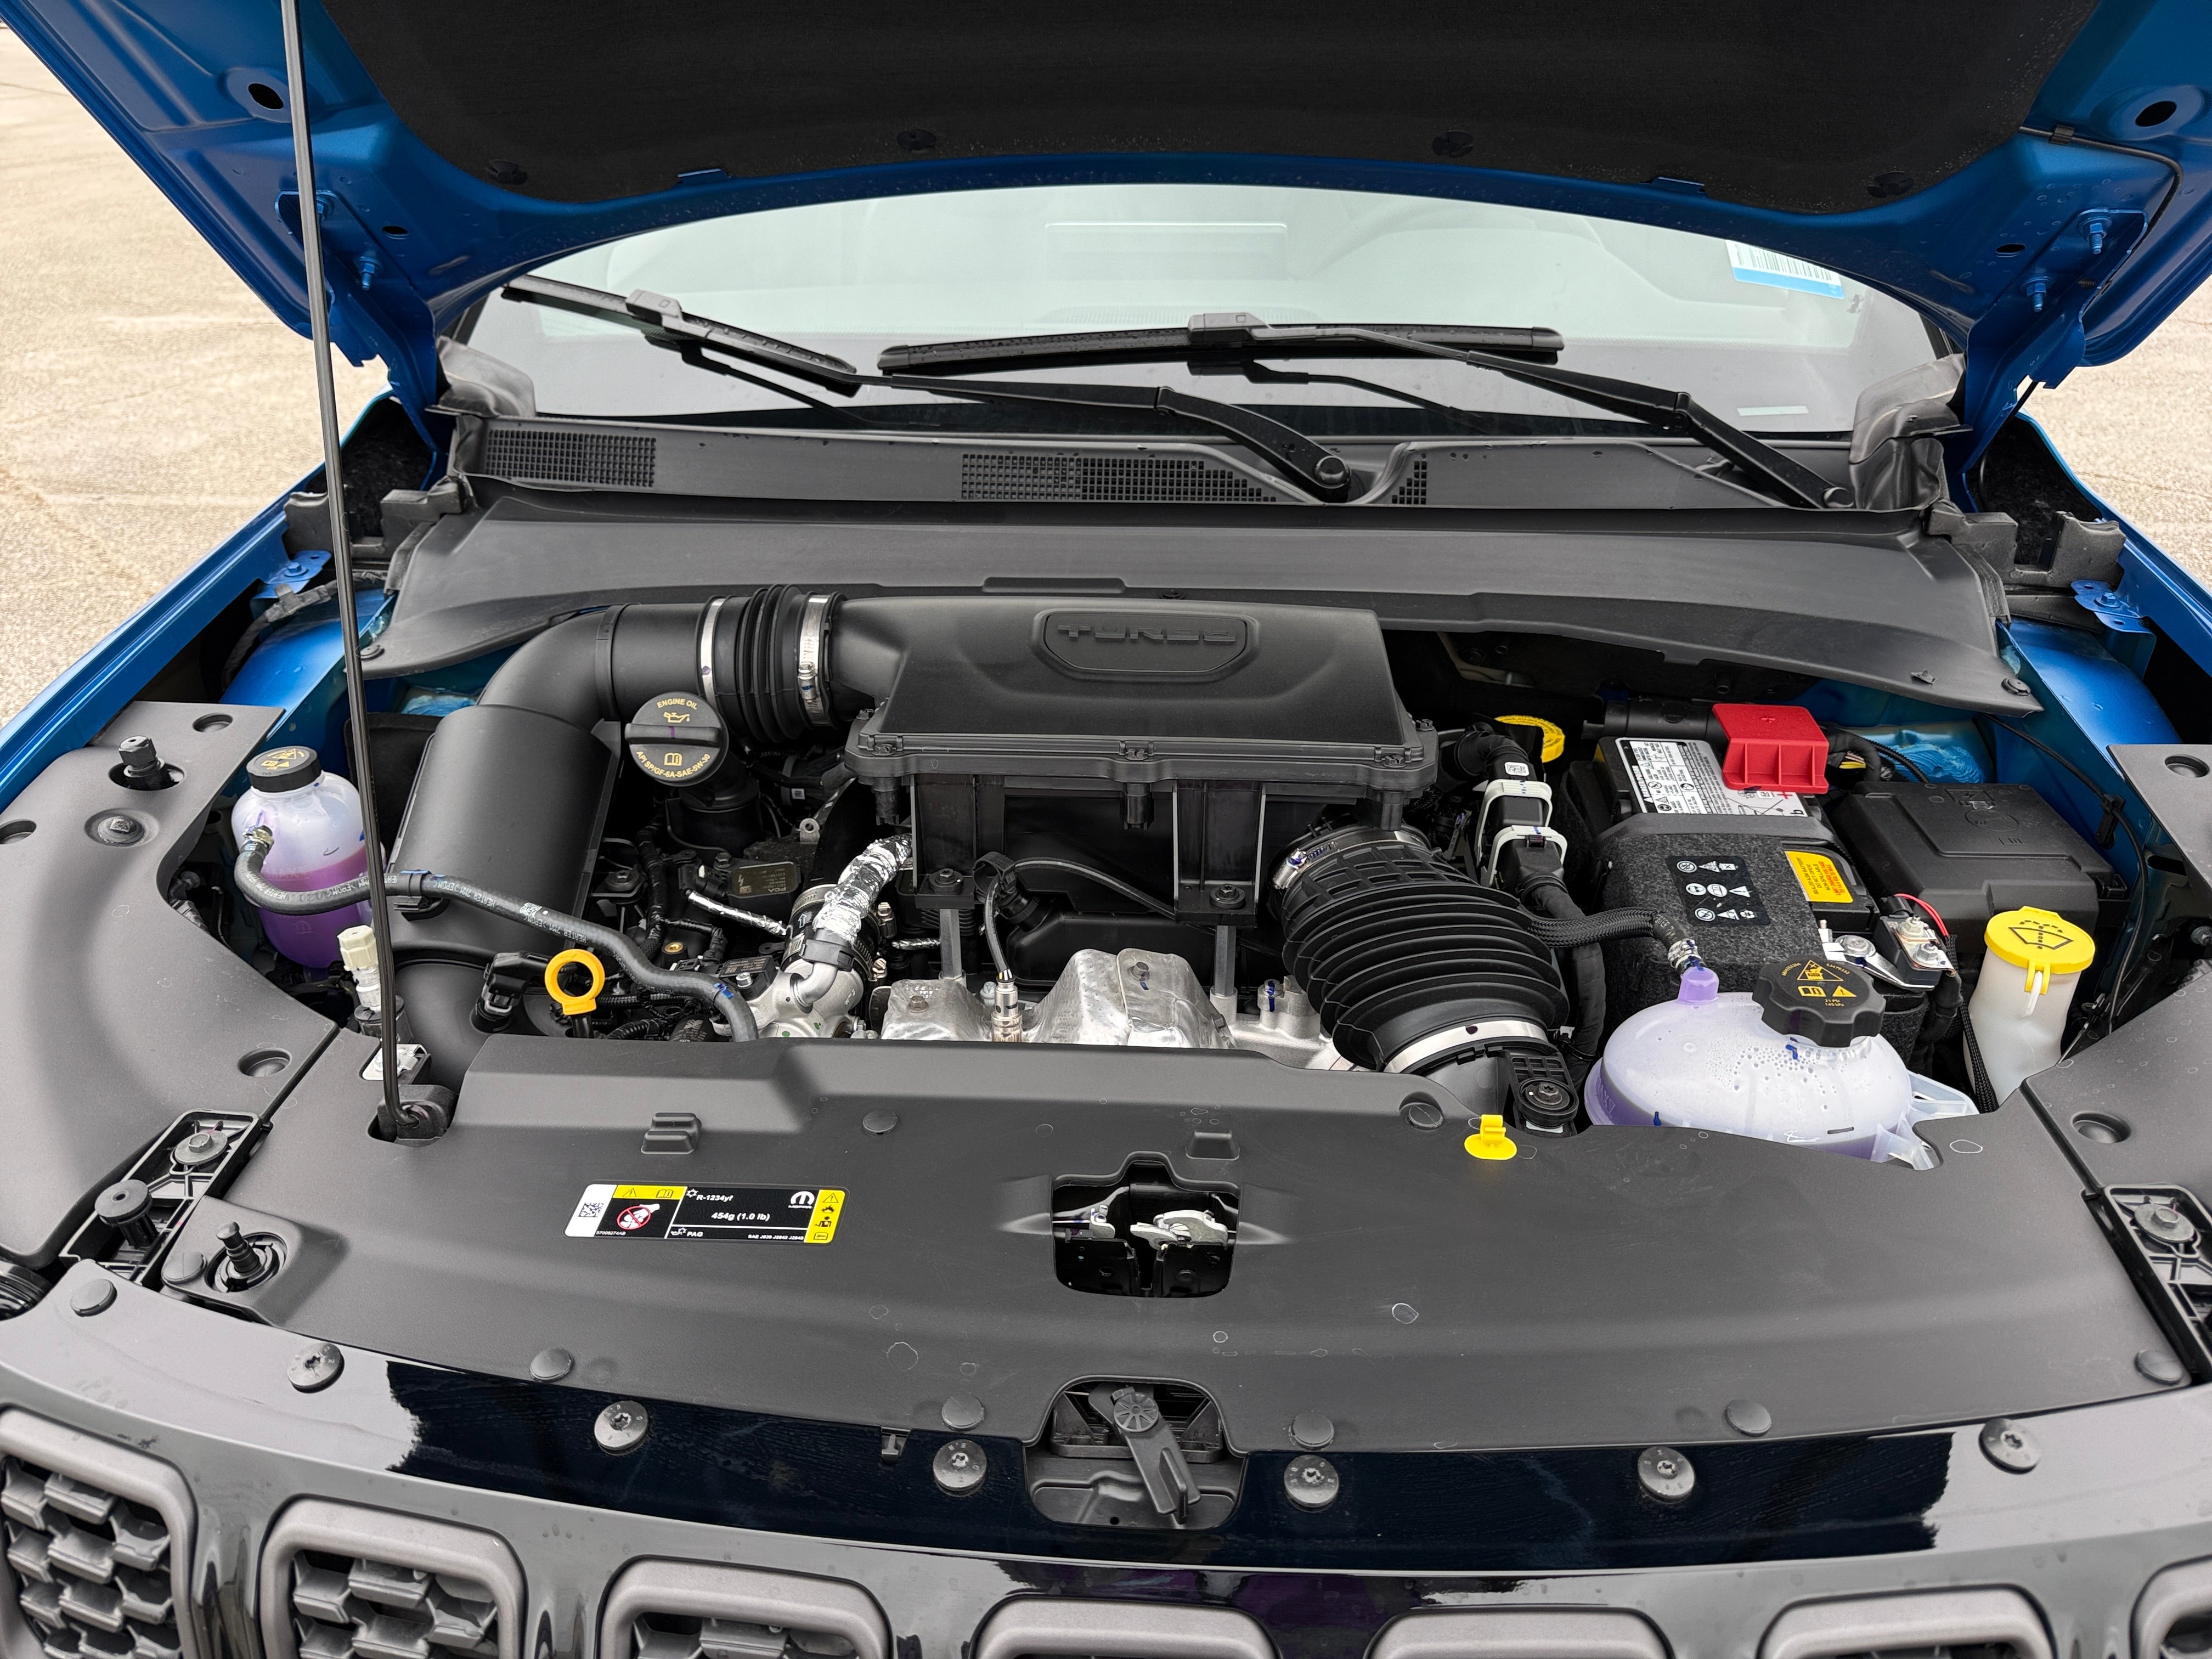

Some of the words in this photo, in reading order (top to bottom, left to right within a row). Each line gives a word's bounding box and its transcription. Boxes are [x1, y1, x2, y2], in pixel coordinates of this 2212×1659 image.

[1057, 624, 1236, 642] TURBO
[657, 698, 685, 708] ENGINE
[686, 700, 697, 710] OIL
[636, 751, 648, 763] API
[644, 753, 711, 778] SP/GF-6A-SAE-5W-30
[1796, 857, 1808, 872] BATTERY
[473, 891, 496, 908] HEATER
[563, 927, 586, 943] HEATER
[711, 1212, 735, 1221] 454g
[757, 1213, 770, 1222] lb)
